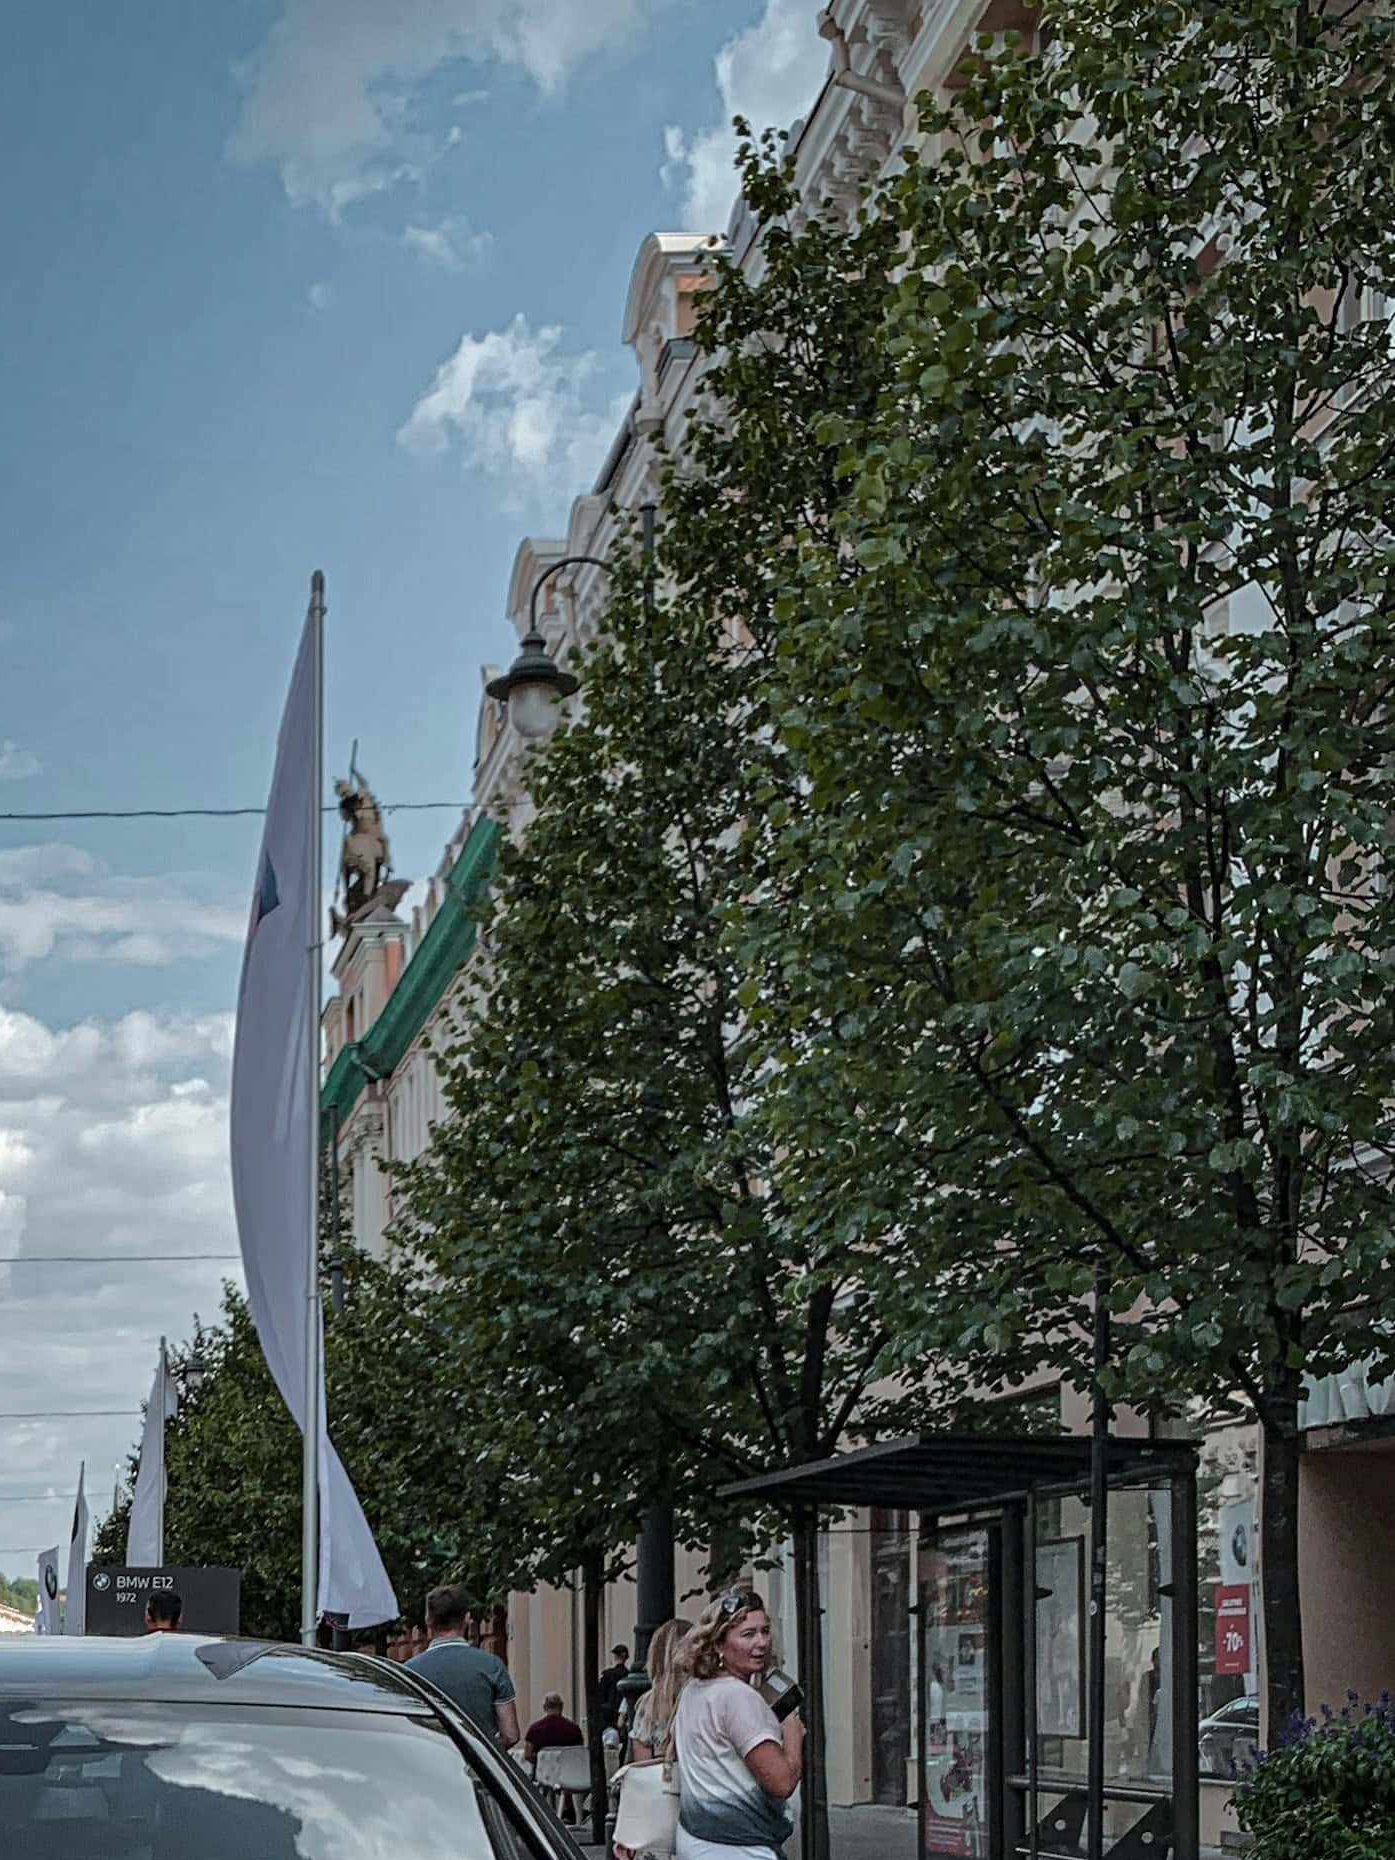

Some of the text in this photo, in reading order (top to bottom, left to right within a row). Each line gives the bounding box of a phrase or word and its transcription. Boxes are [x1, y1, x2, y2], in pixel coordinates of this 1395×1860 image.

[116, 1575, 174, 1589] BMW E12
[115, 1592, 137, 1603] 1972
